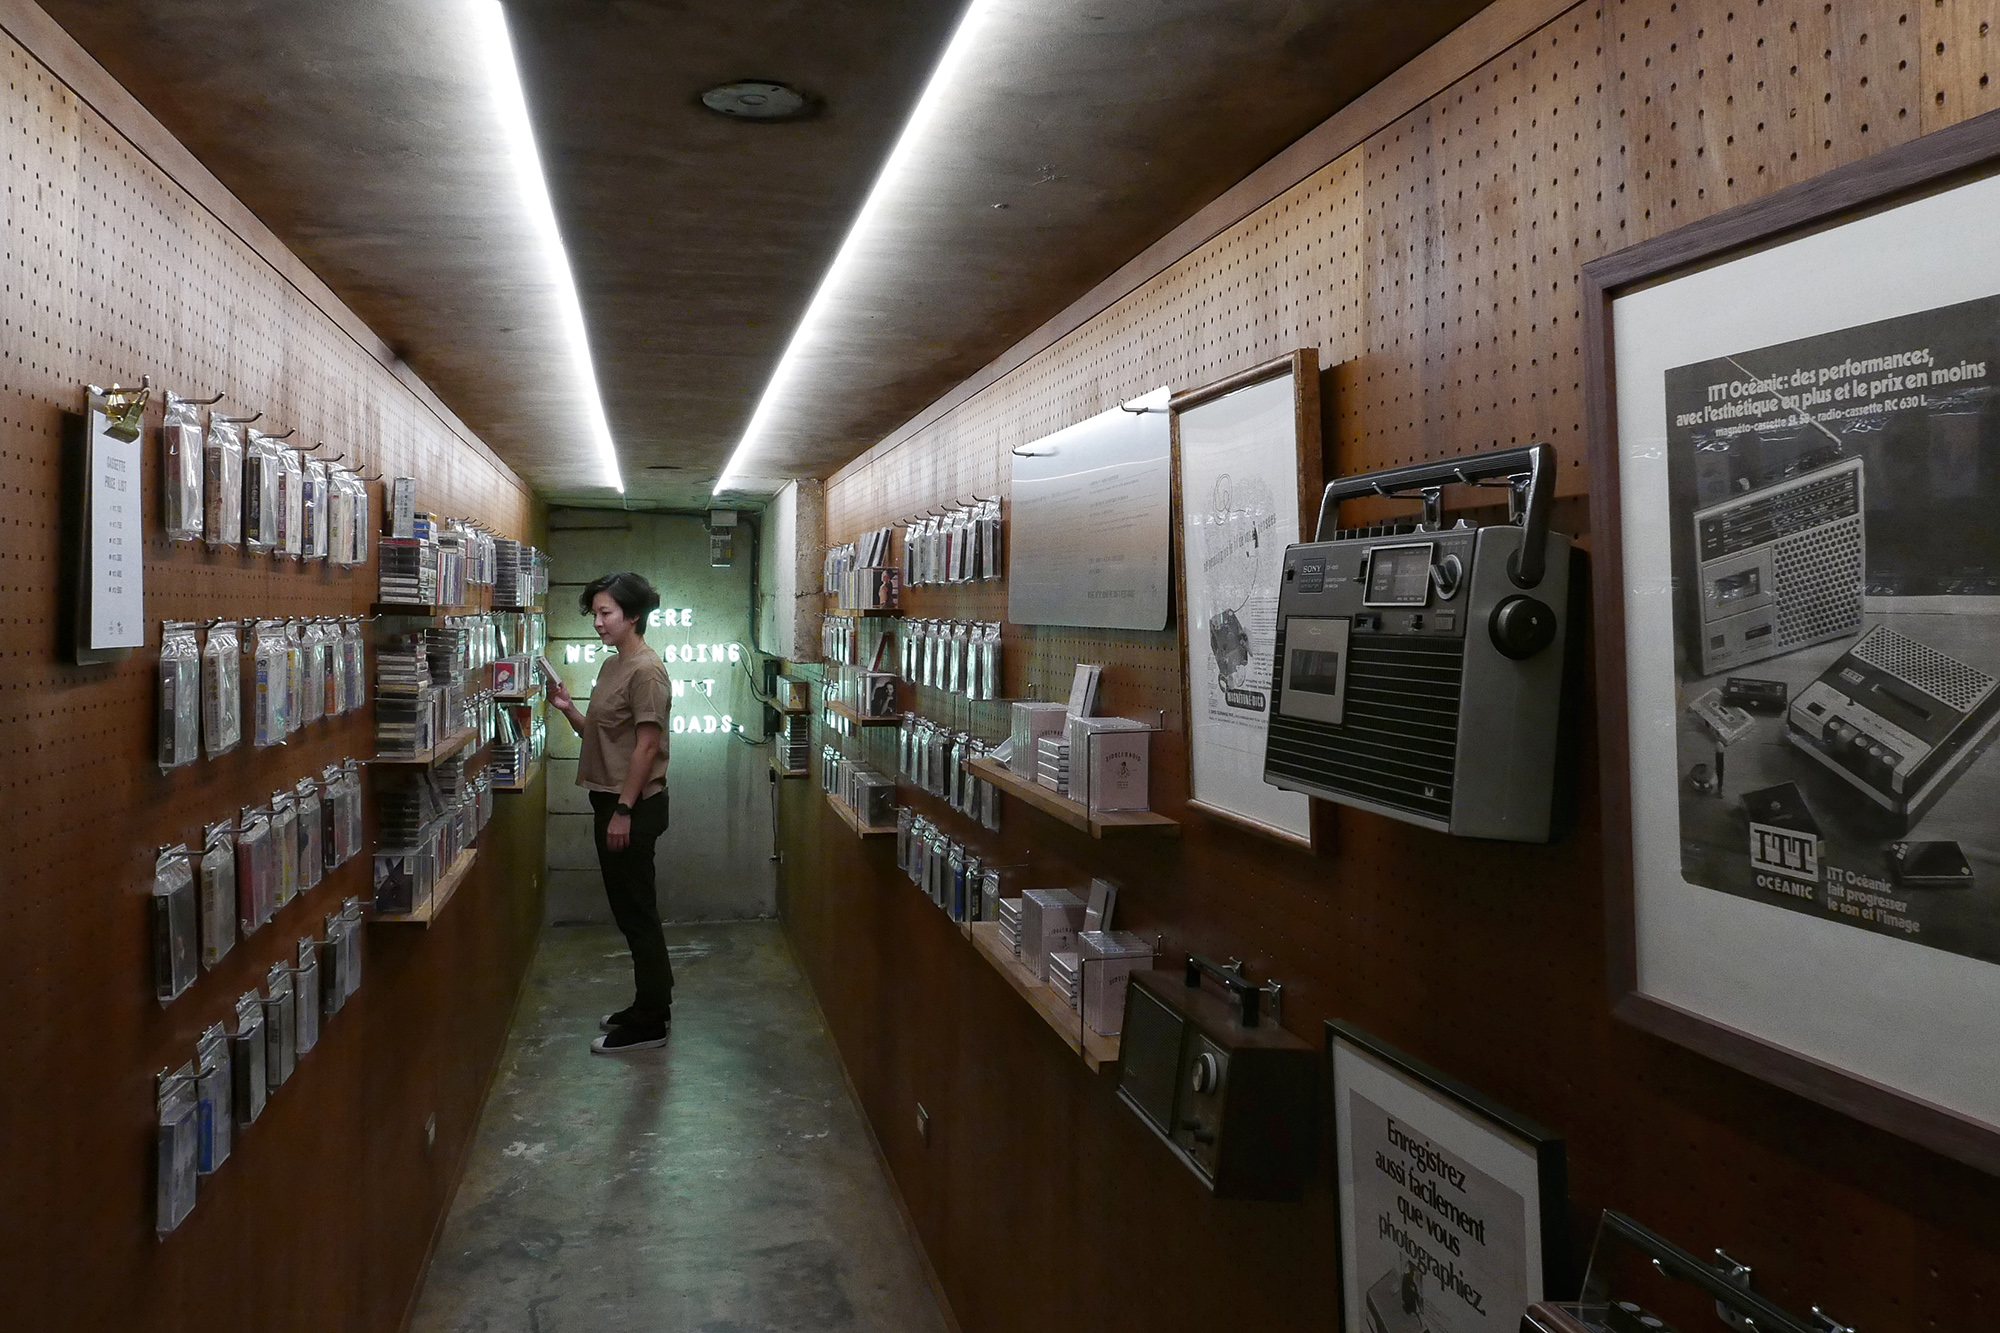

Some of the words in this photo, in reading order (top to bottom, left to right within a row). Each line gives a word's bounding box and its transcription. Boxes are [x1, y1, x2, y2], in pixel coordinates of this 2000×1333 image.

[1708, 382, 1728, 402] ITT
[1791, 366, 1816, 388] des
[1819, 348, 1934, 389] performances,
[1676, 409, 1702, 427] avec
[1704, 396, 1778, 424] l'esthétique
[1781, 394, 1800, 410] en
[1802, 388, 1832, 413] plus
[1834, 380, 1850, 400] et
[1852, 377, 1867, 397] le
[1870, 372, 1904, 399] prix
[1905, 373, 1929, 389] en
[1931, 362, 1986, 384] moins
[1715, 417, 1786, 438] magnéto-cassette
[1818, 404, 1882, 422] radio-cassette
[1884, 399, 1898, 413] RC
[1899, 395, 1918, 411] 630
[107, 456, 126, 473] CASSETTE
[104, 475, 116, 490] PRICE
[117, 479, 127, 493] LIST
[1303, 565, 1322, 573] SONY
[650, 608, 693, 627] ERE
[665, 644, 740, 663] GOING
[673, 716, 745, 733] OADS.
[1754, 829, 1814, 874] ITT
[1756, 874, 1813, 900] OCÉANIC
[1826, 866, 1844, 881] ITT
[1846, 870, 1892, 893] Océanic
[1827, 884, 1844, 898] fait
[1846, 890, 1907, 912] progresser
[1828, 897, 1838, 911] le
[1840, 902, 1860, 916] son
[1862, 907, 1874, 920] et
[1876, 911, 1920, 933] l'image
[1387, 1117, 1466, 1193] Enregistrez
[1375, 1150, 1405, 1185] aussi
[1409, 1167, 1486, 1246] facilement
[1397, 1194, 1423, 1228] que
[1427, 1216, 1461, 1257] vous
[1378, 1212, 1487, 1316] photographiez.
